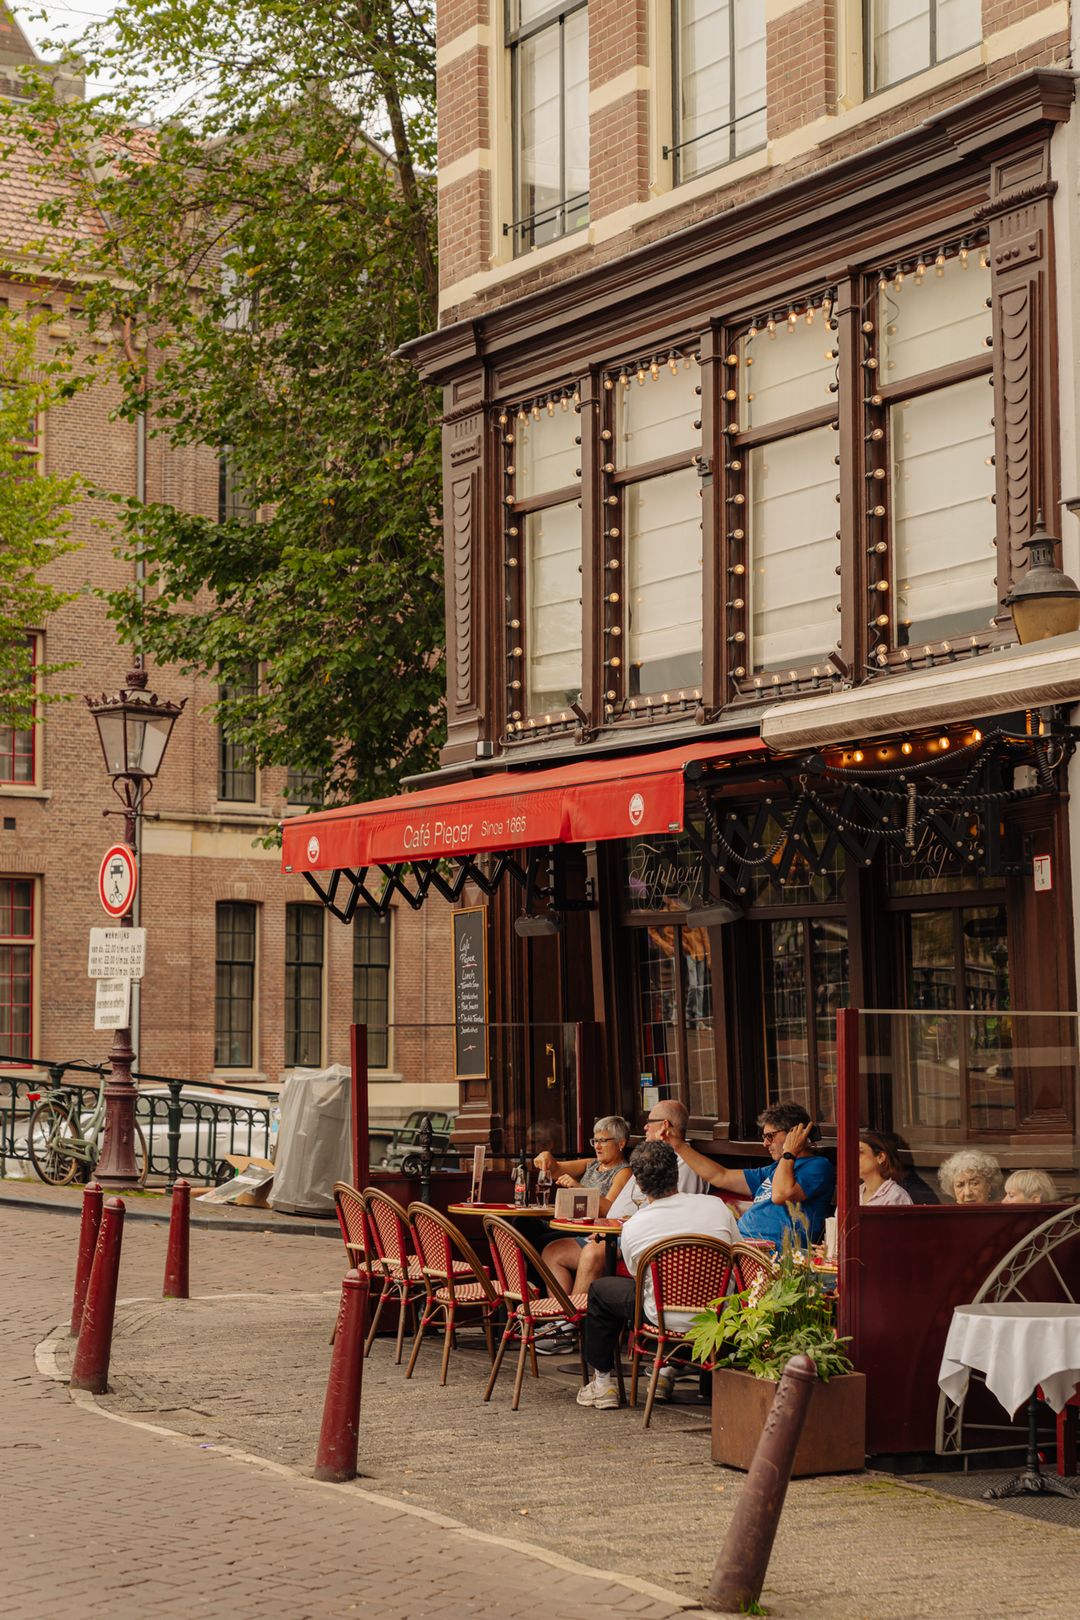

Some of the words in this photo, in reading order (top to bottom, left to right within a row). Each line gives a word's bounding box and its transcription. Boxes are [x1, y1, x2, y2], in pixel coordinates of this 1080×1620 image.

[403, 822, 431, 849] Café
[434, 820, 473, 848] Pieper
[481, 820, 503, 837] Since
[506, 815, 527, 833] 1665
